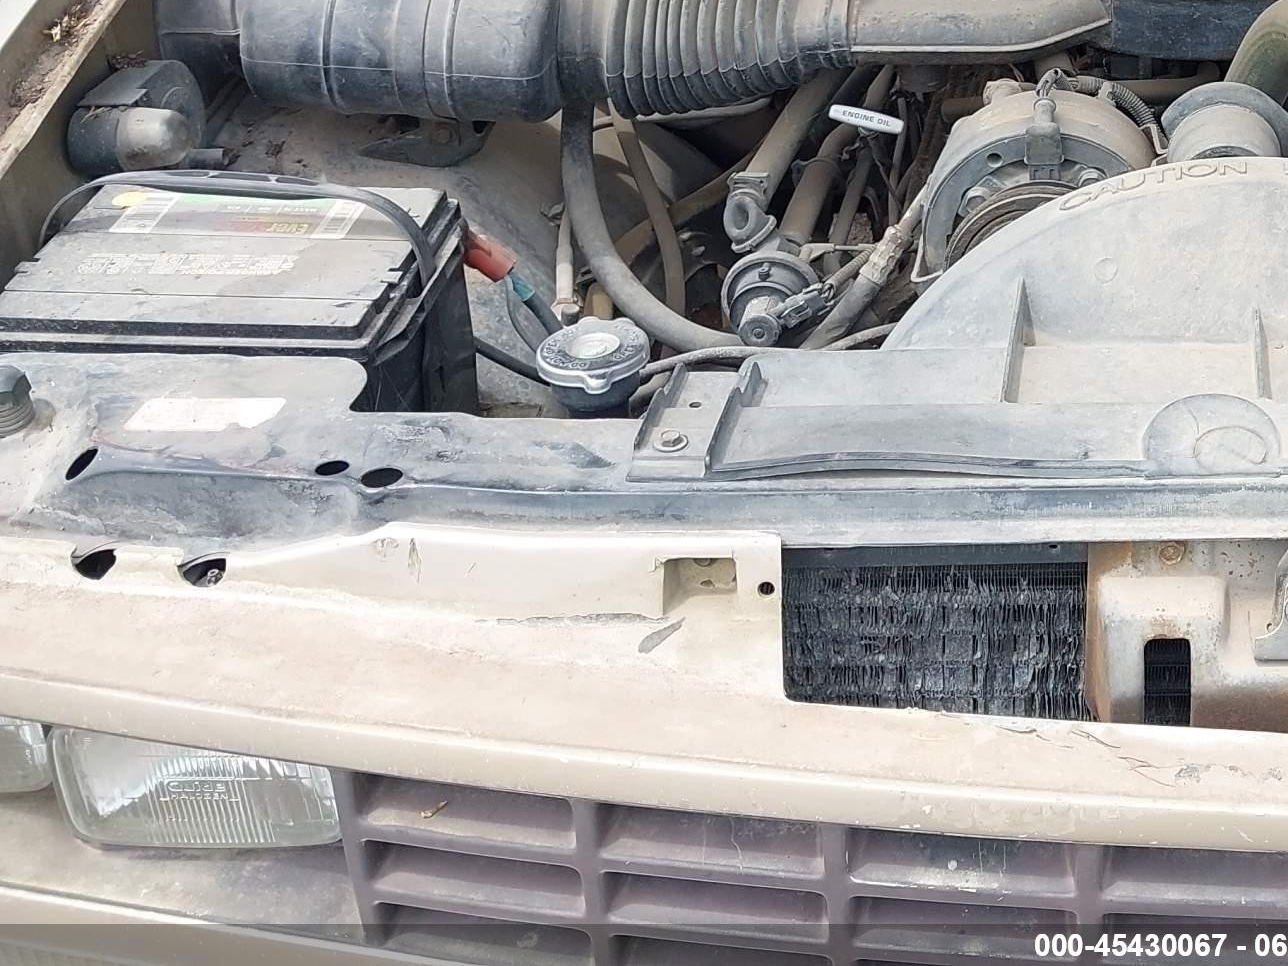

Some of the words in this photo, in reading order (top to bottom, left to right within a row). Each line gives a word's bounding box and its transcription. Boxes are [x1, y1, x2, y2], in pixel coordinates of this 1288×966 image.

[842, 110, 875, 122] ENGINE
[877, 118, 891, 127] OIL
[1059, 161, 1248, 211] CAUTION
